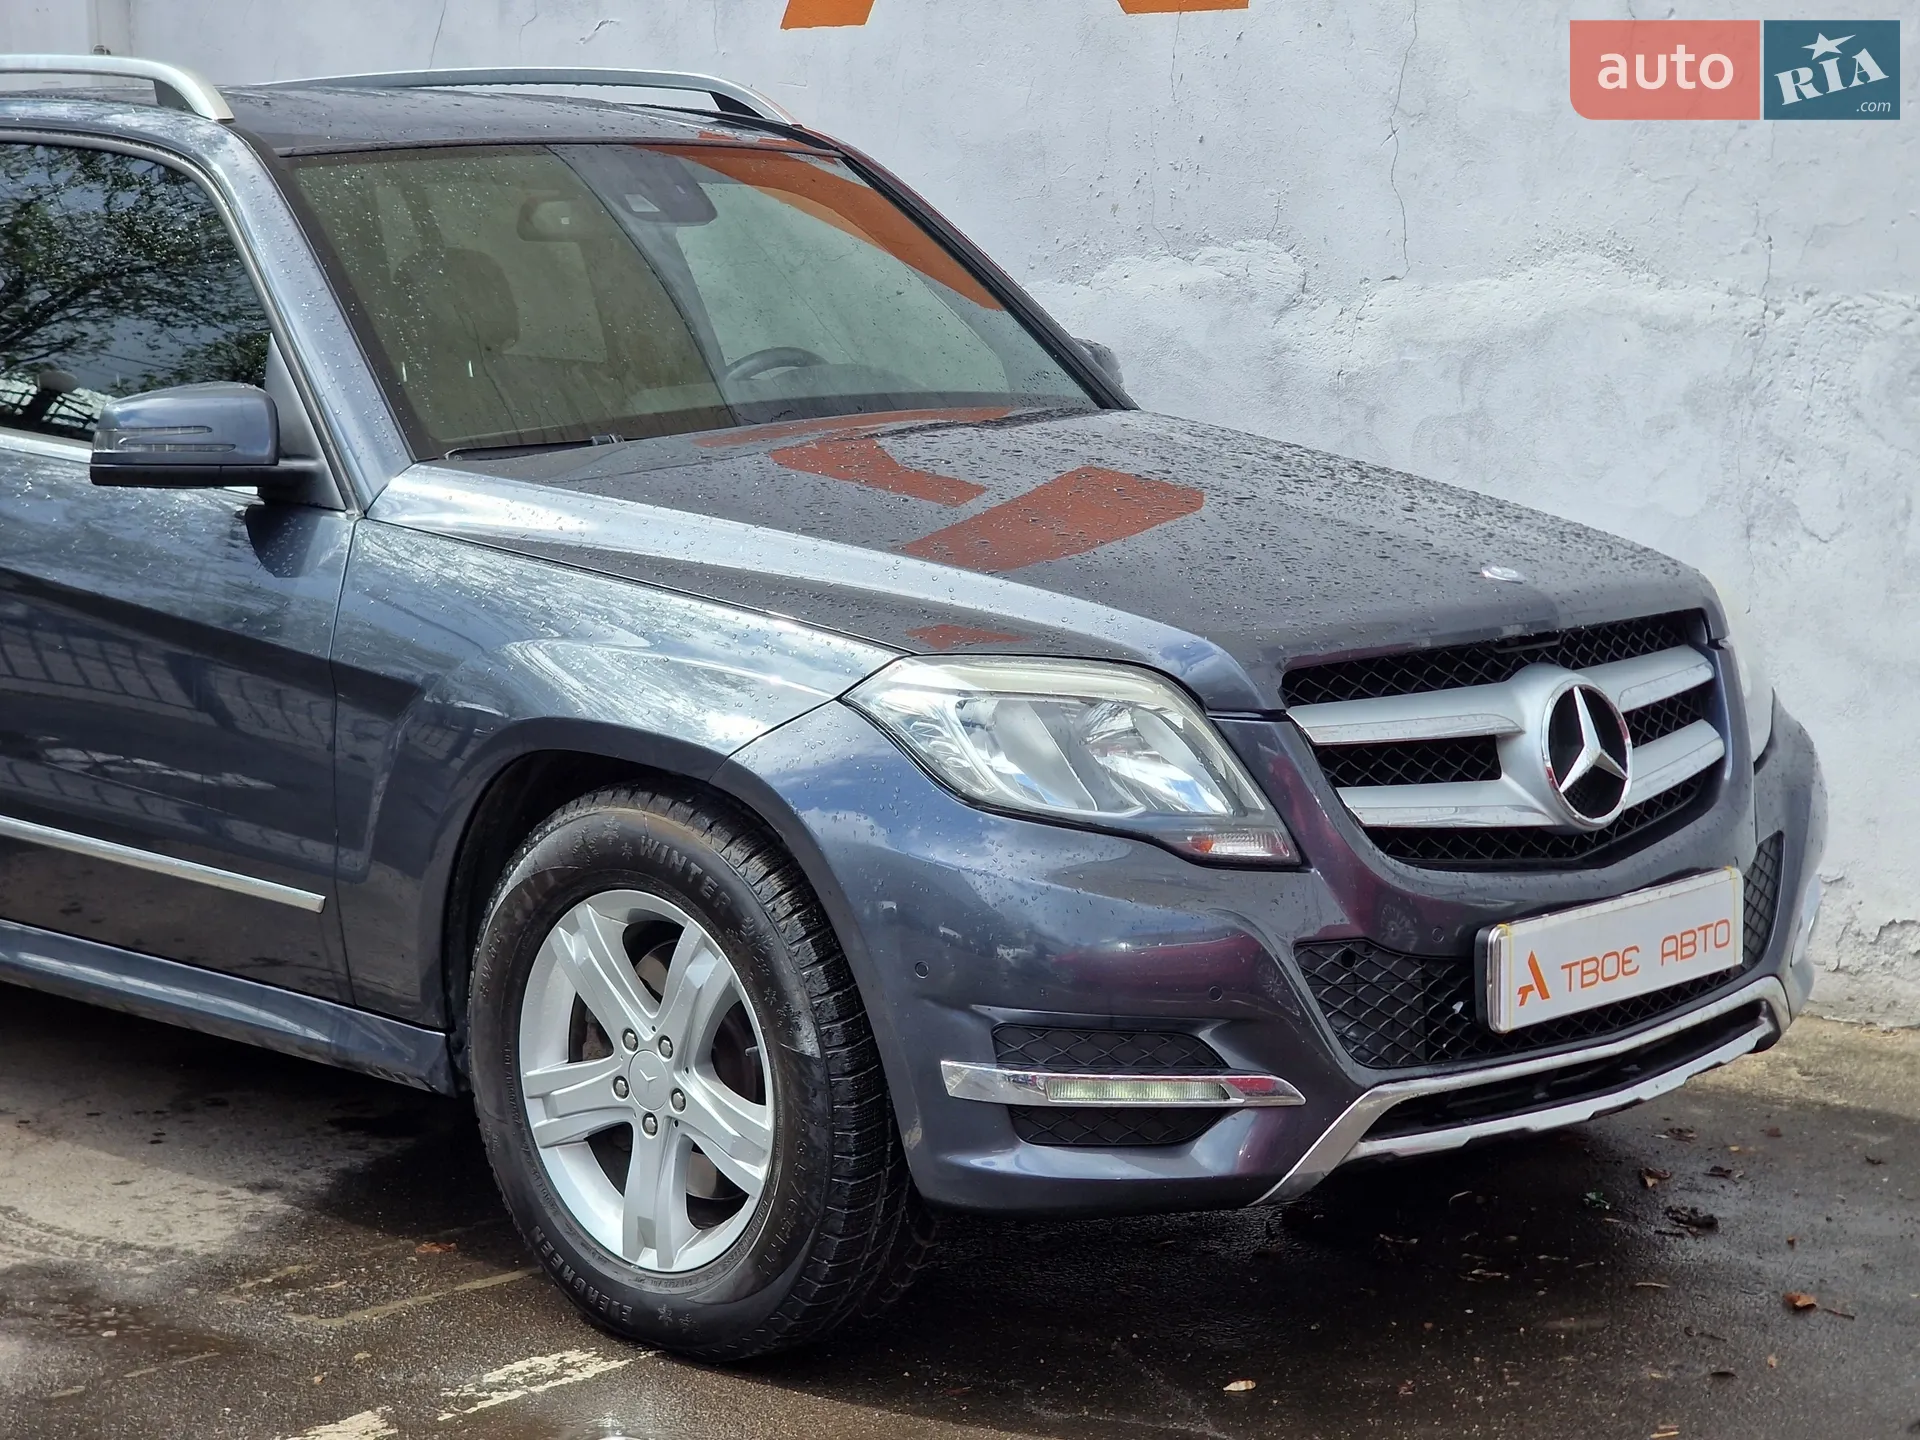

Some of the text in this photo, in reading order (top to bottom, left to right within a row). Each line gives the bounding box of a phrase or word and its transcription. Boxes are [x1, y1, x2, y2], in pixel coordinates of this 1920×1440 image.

[640, 835, 732, 915] WINTER
[1560, 945, 1640, 993] ТВОЄ
[1661, 918, 1731, 967] АВТО
